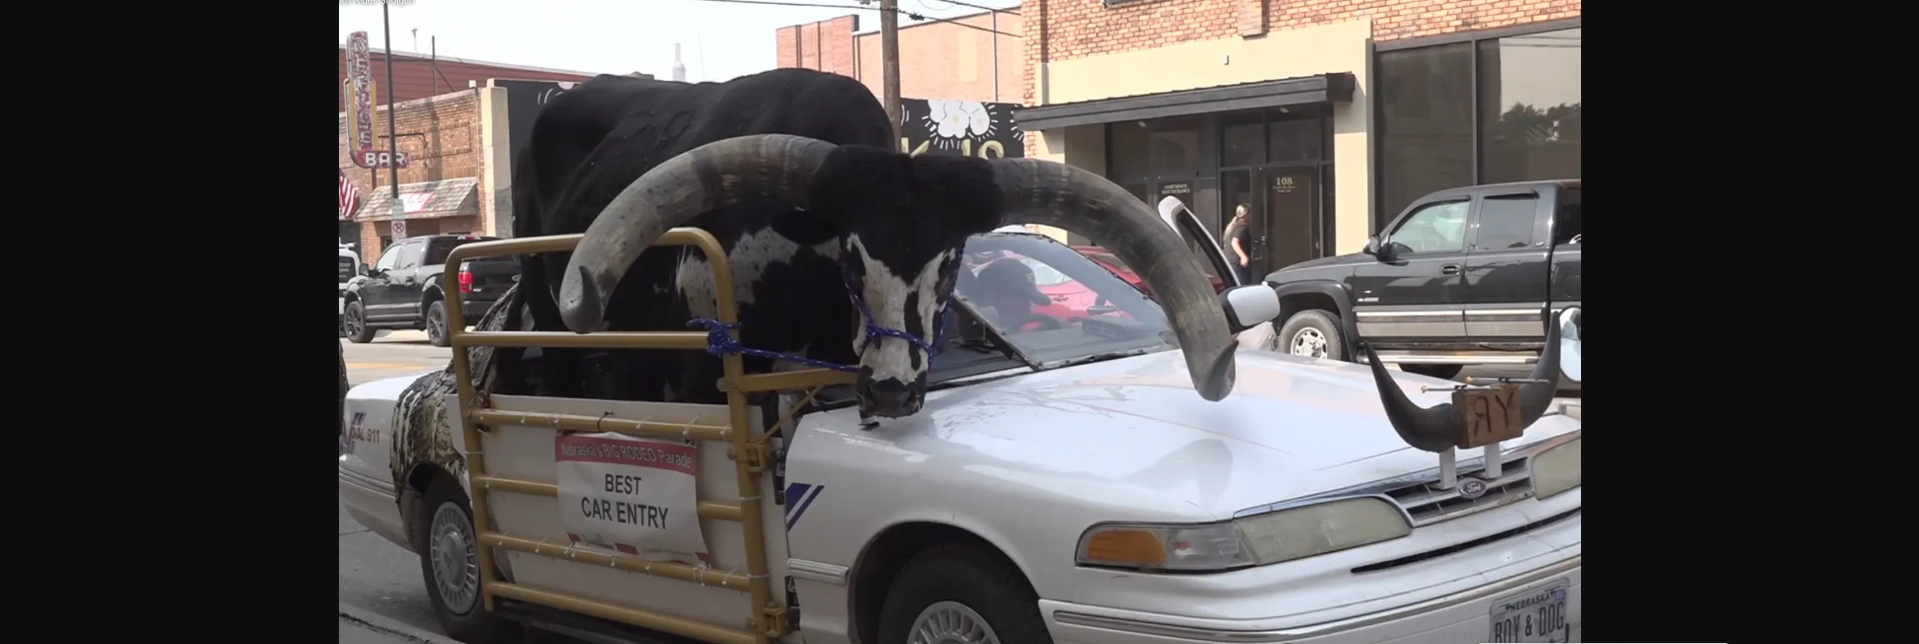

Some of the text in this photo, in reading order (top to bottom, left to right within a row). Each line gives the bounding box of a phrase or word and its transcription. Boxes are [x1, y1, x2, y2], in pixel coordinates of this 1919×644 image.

[365, 152, 405, 166] BAR
[1276, 176, 1293, 186] 108
[367, 428, 380, 443] 911
[561, 442, 692, 468] Nebraska's BIG RODEO Parade
[605, 473, 642, 495] BEST
[581, 496, 669, 529] CAR ENTRY
[1511, 592, 1550, 612] NEBRASKA
[1495, 601, 1564, 643] BOY & DOG
